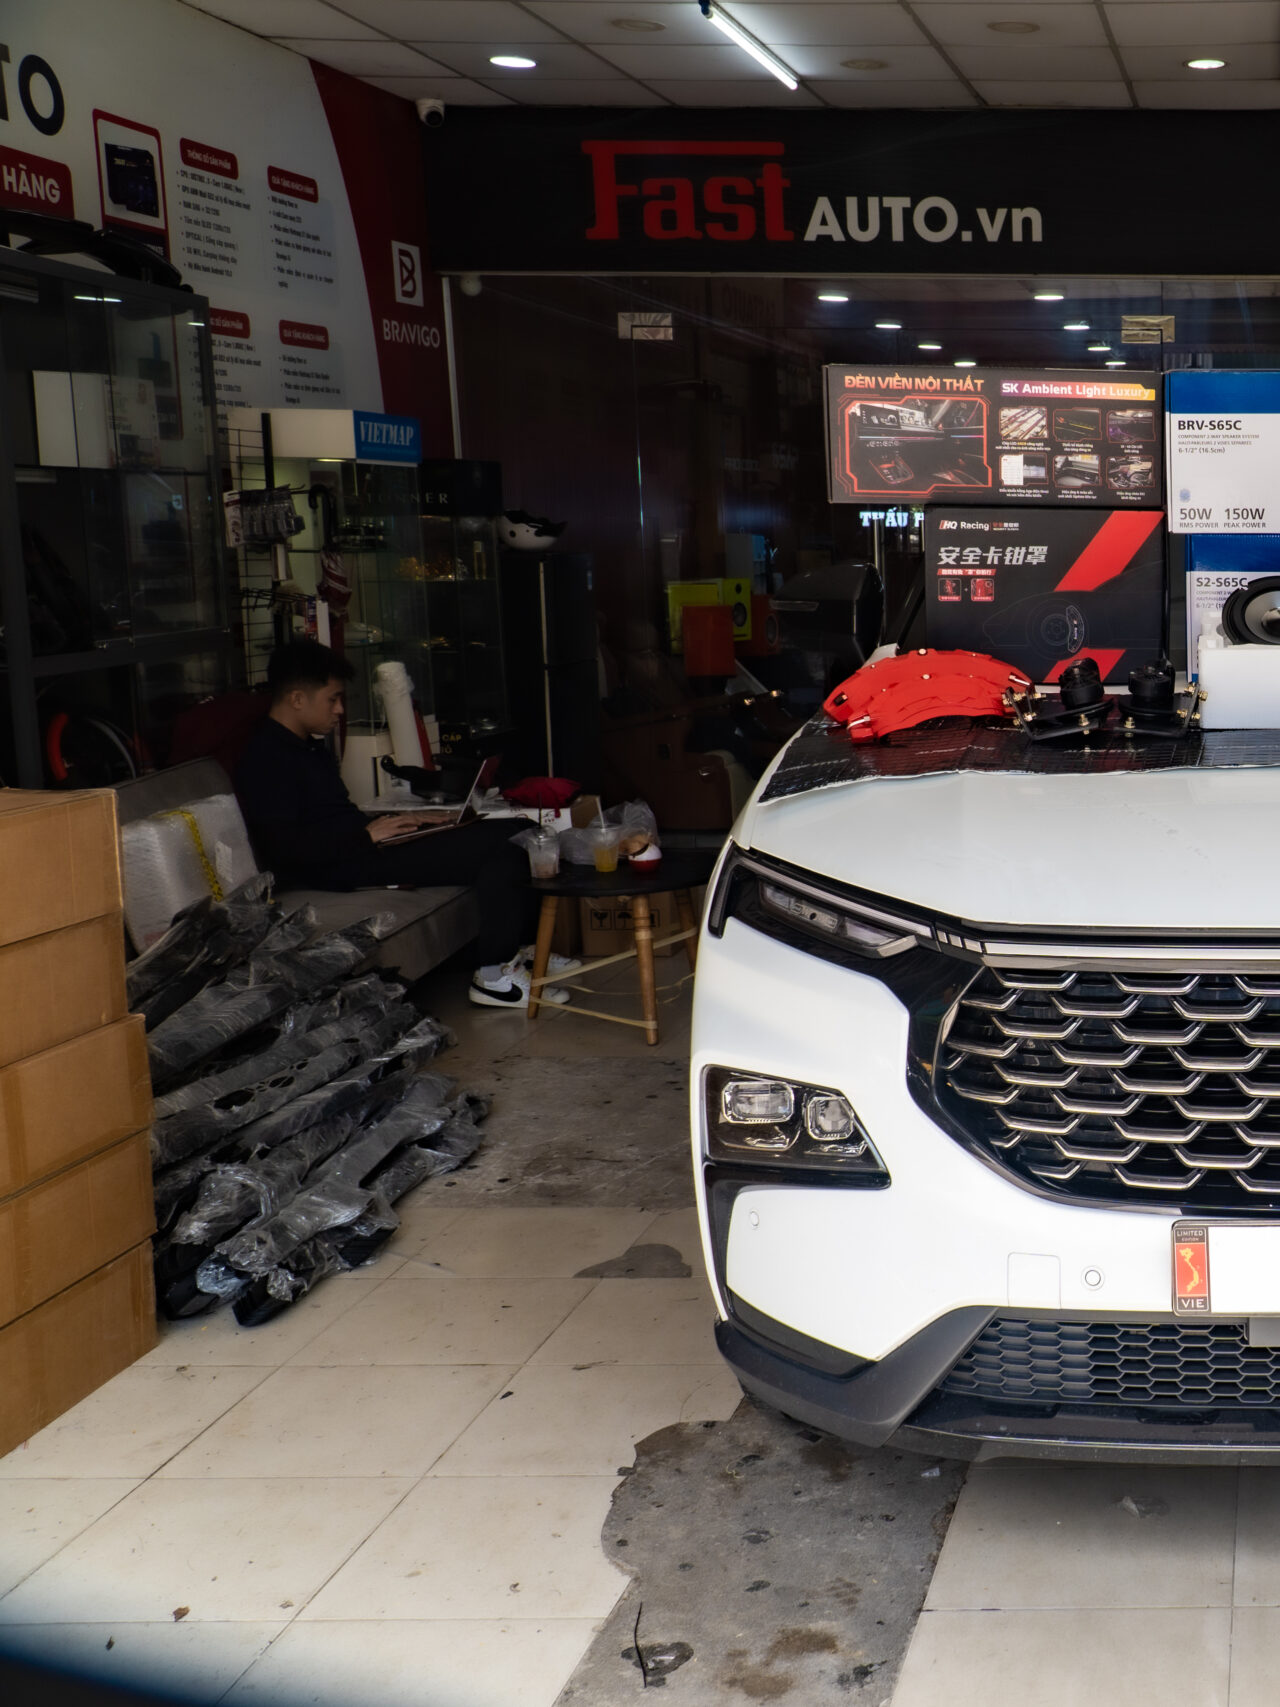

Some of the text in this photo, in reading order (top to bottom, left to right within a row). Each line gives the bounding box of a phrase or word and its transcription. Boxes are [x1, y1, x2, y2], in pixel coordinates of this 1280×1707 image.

[582, 140, 1043, 242] Fast AUTO.vn
[382, 318, 441, 348] BRAVIGO
[844, 373, 876, 389] ĐÈN
[914, 375, 941, 393] NỘI
[943, 374, 985, 392] THẤT
[1002, 382, 1019, 394] SK
[1022, 383, 1073, 395] Ambient
[1110, 386, 1151, 399] Luxury
[360, 420, 415, 447] VIETMAP
[1178, 419, 1242, 431] BRV-S65C
[1180, 508, 1266, 520] 50W 150W
[941, 520, 958, 530] HQ
[960, 521, 990, 531] Racing
[937, 546, 1048, 566] 安全卡钳罩
[1196, 577, 1248, 588] S2-S65C
[1181, 1298, 1205, 1309] VIE
